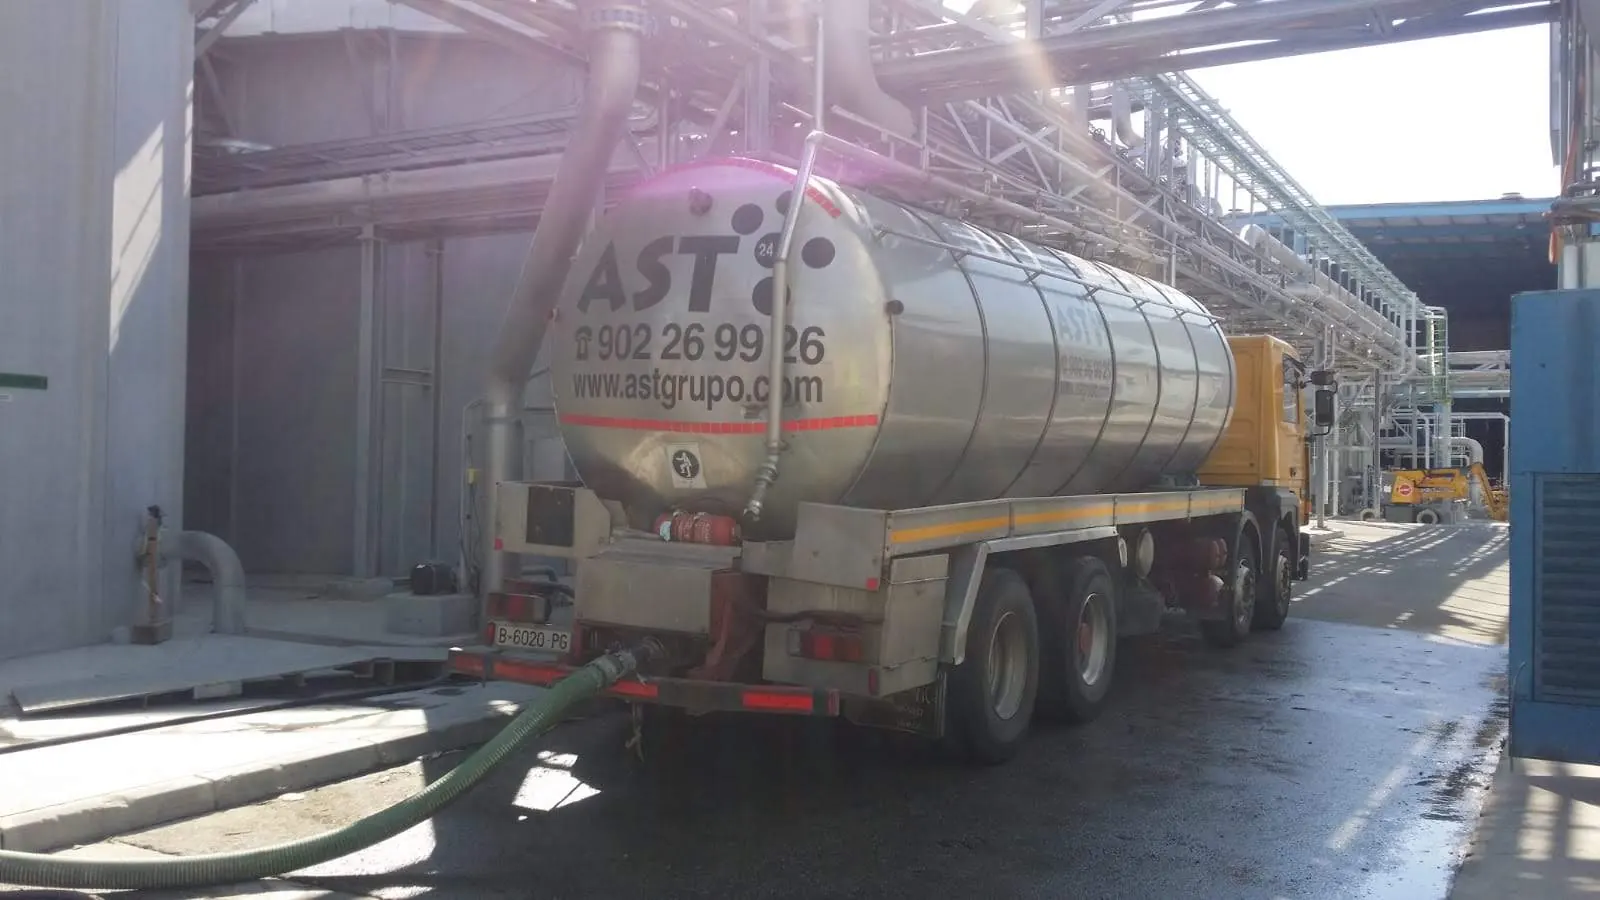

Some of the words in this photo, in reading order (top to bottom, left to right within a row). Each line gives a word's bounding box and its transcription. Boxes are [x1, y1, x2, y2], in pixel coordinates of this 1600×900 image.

[576, 235, 740, 313] AST
[598, 323, 652, 361] 902
[661, 323, 704, 361] 26
[714, 323, 764, 362] 99
[783, 324, 826, 365] 26
